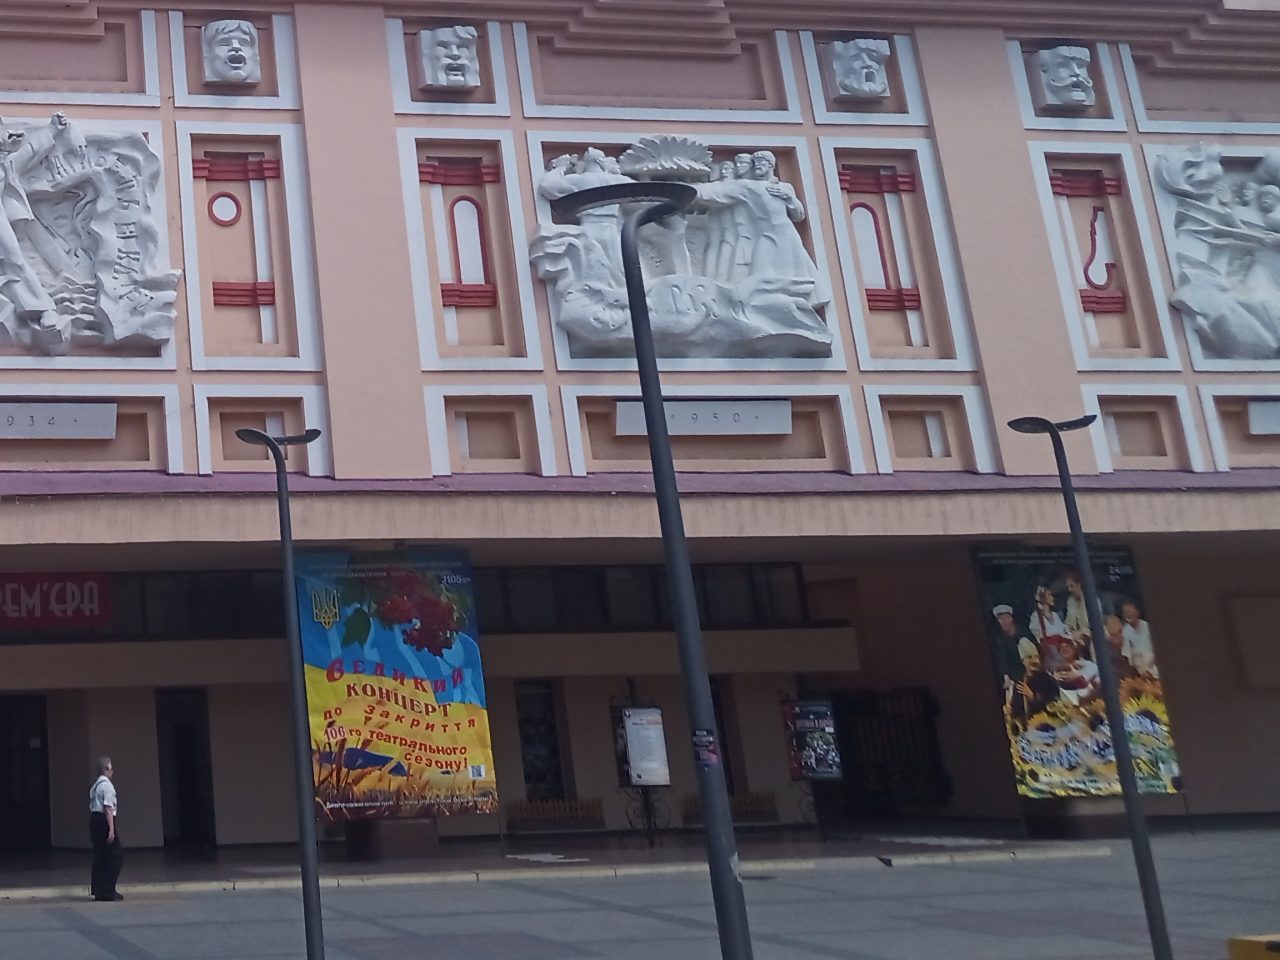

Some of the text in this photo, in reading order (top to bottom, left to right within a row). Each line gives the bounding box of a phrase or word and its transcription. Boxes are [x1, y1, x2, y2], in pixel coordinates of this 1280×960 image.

[323, 706, 343, 721] до
[346, 682, 452, 717] КОНЦЕРТ
[368, 728, 468, 756] театрального
